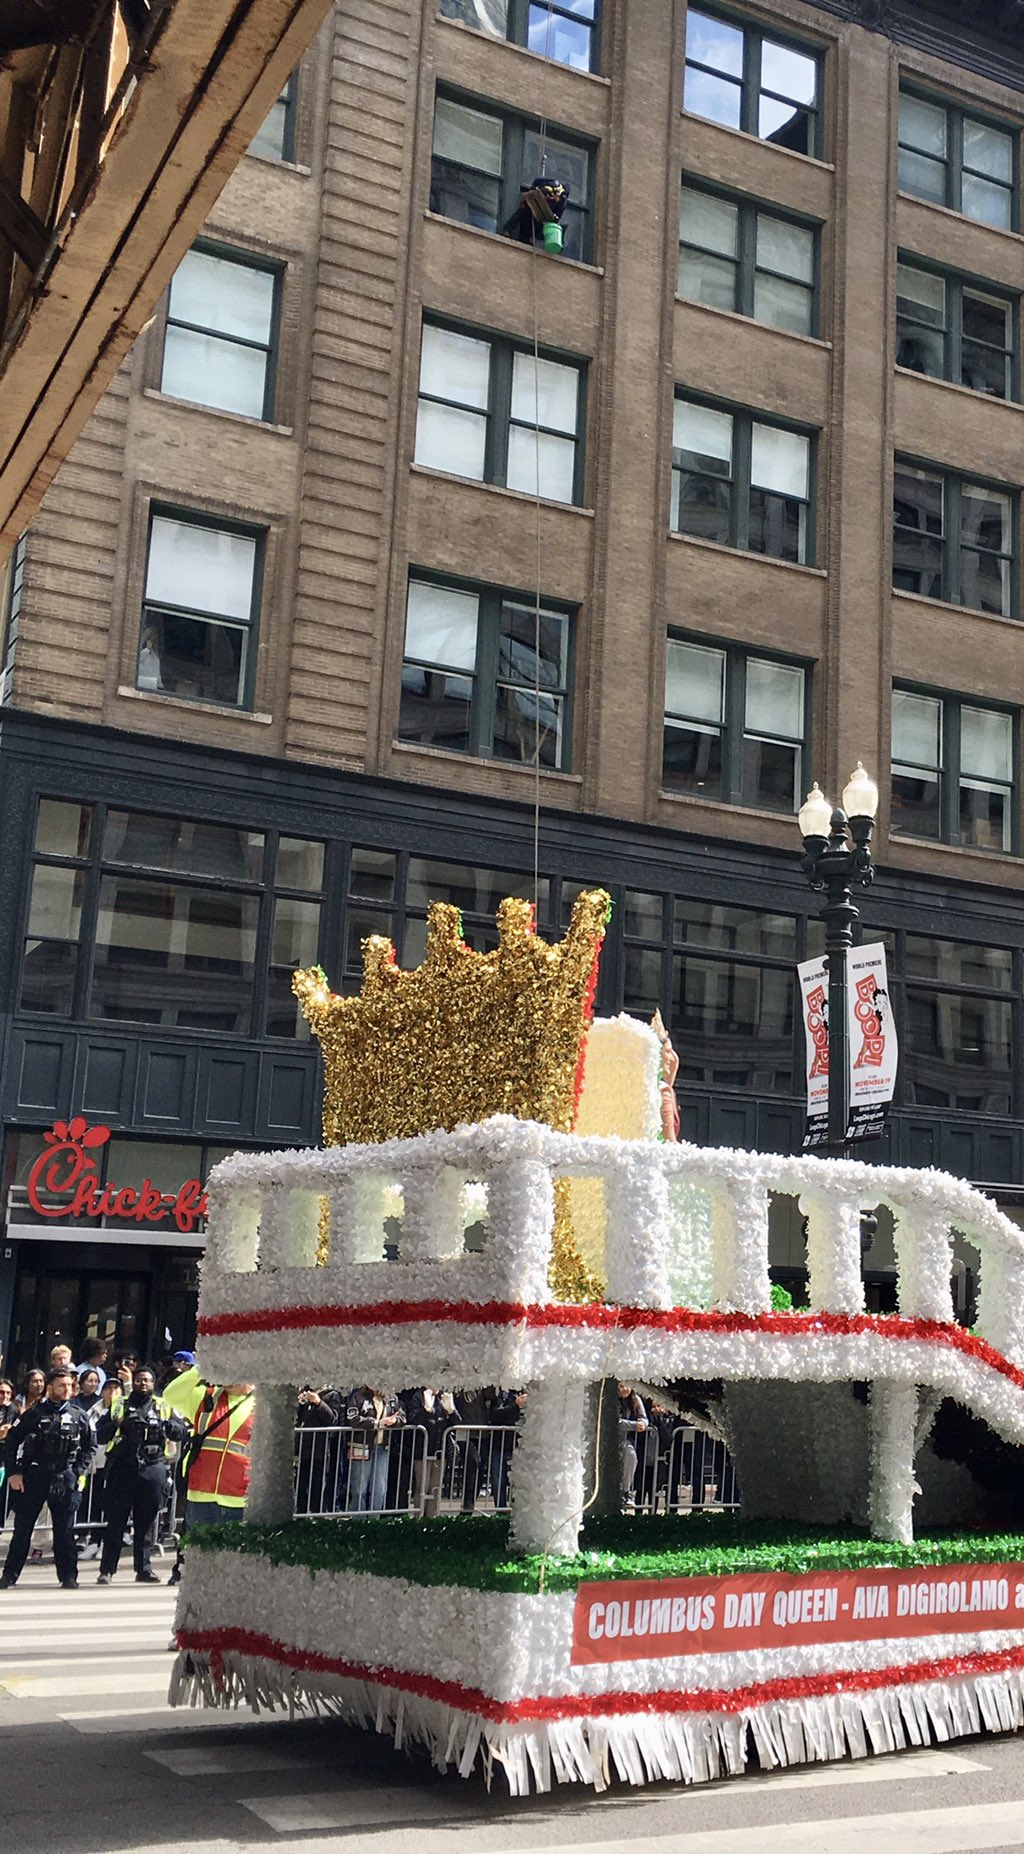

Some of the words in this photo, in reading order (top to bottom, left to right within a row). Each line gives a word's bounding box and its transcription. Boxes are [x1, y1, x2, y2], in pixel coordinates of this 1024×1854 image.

[854, 973, 886, 1067] BOOP!
[27, 1141, 209, 1232] Chick-f
[588, 1594, 716, 1640] COLUMBUS
[723, 1591, 767, 1629] DAY
[772, 1588, 838, 1628] QUEEN
[852, 1585, 889, 1619] AVA
[896, 1578, 1009, 1617] DIGIROLAMO
